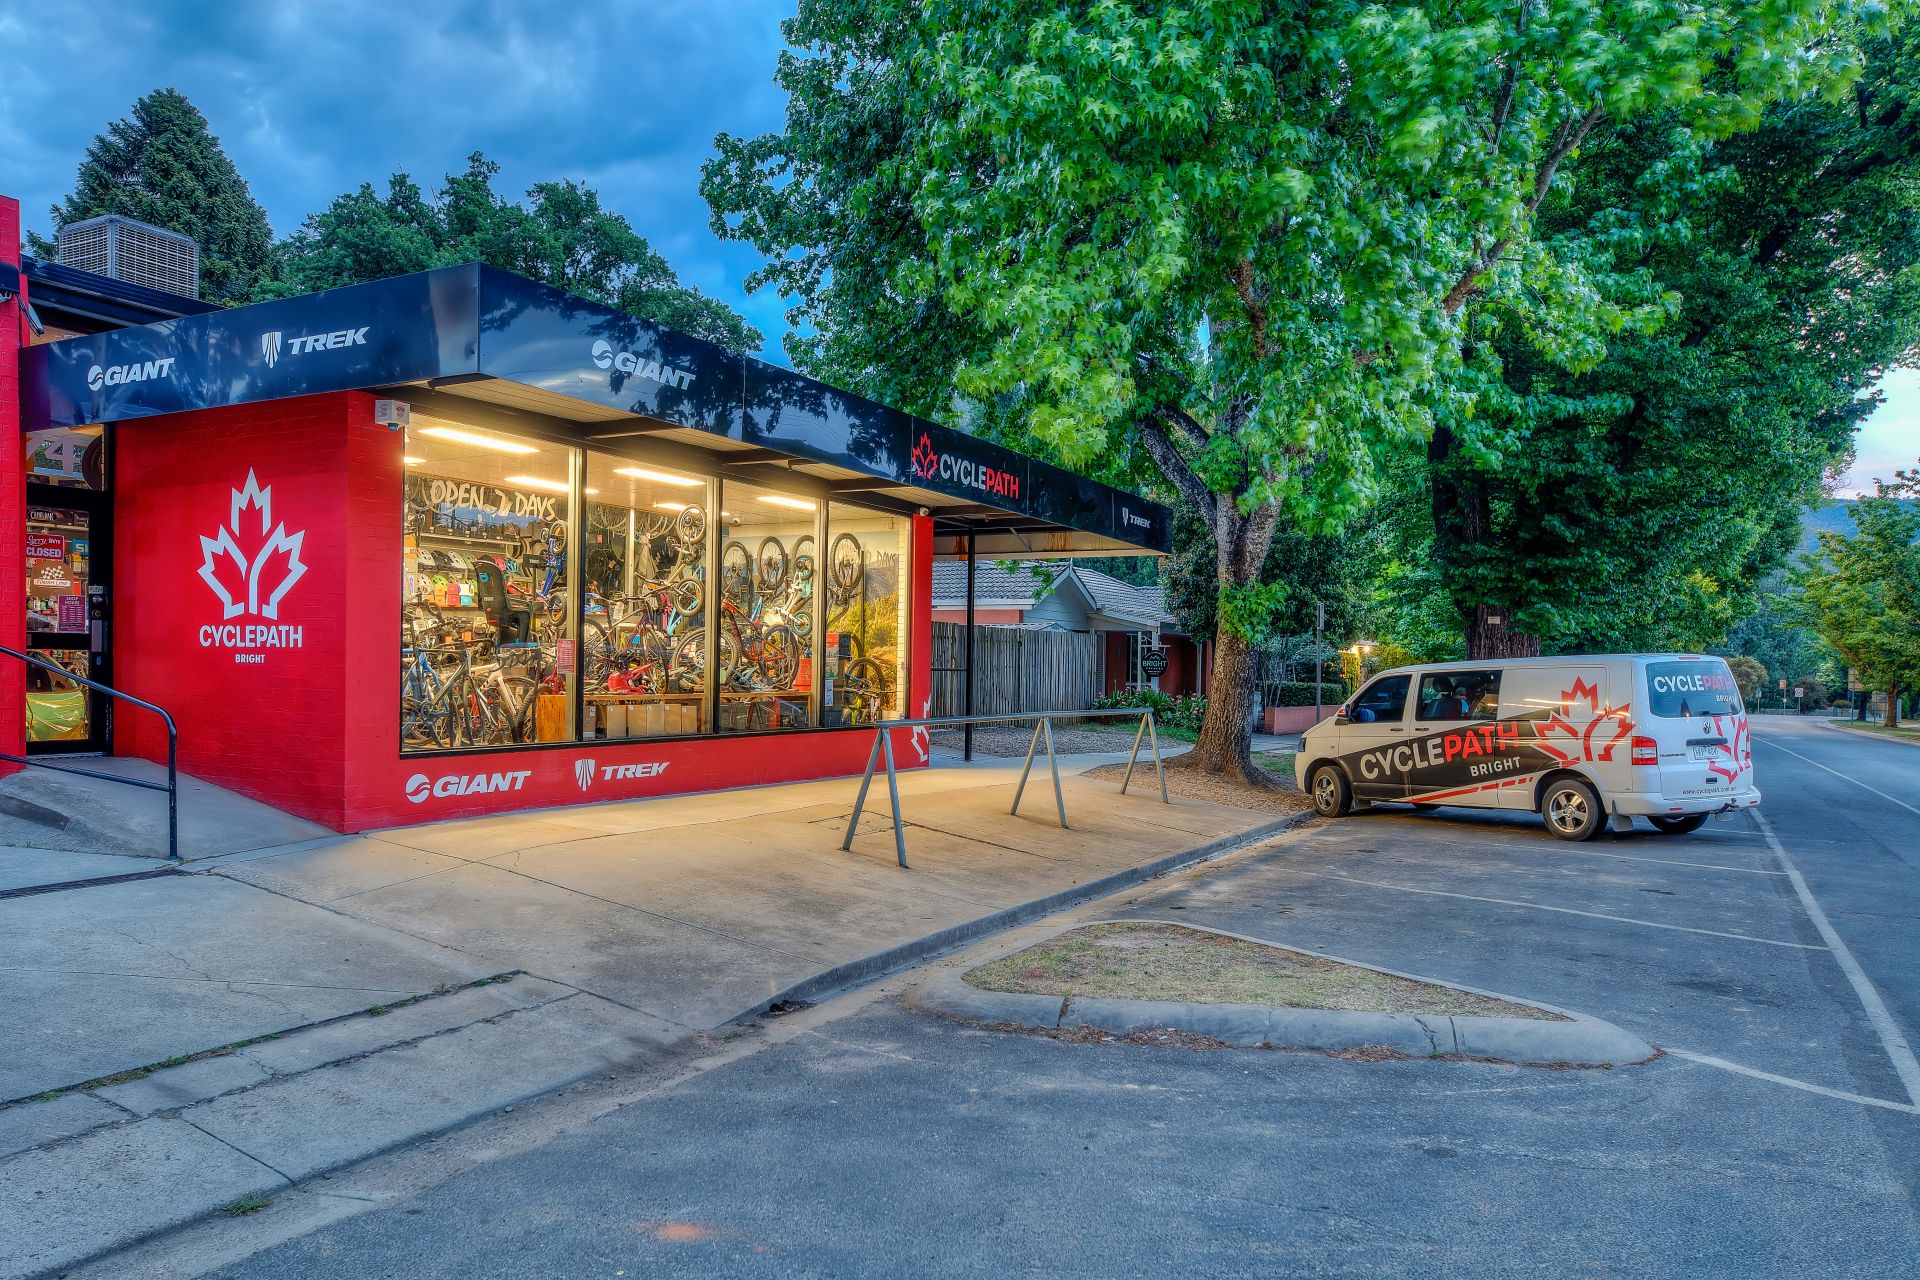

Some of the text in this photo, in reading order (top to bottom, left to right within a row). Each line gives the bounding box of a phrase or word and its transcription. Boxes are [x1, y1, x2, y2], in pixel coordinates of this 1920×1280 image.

[287, 326, 371, 355] TREK
[105, 357, 175, 387] GIANT
[614, 351, 697, 390] GIANT
[940, 454, 1020, 500] CYCLEPATH
[430, 479, 486, 511] OPEN
[514, 491, 556, 521] DAYS
[1129, 514, 1152, 529] TREK
[26, 546, 62, 558] CLOSED
[198, 624, 303, 649] CYCLEPATH
[234, 653, 266, 665] BRIGHT
[1653, 674, 1734, 693] CYCLEPATH
[1360, 721, 1520, 780] CYCLEPATH
[600, 761, 671, 781] TREK
[1469, 756, 1522, 778] BRIGHT
[432, 770, 532, 798] GIANT
